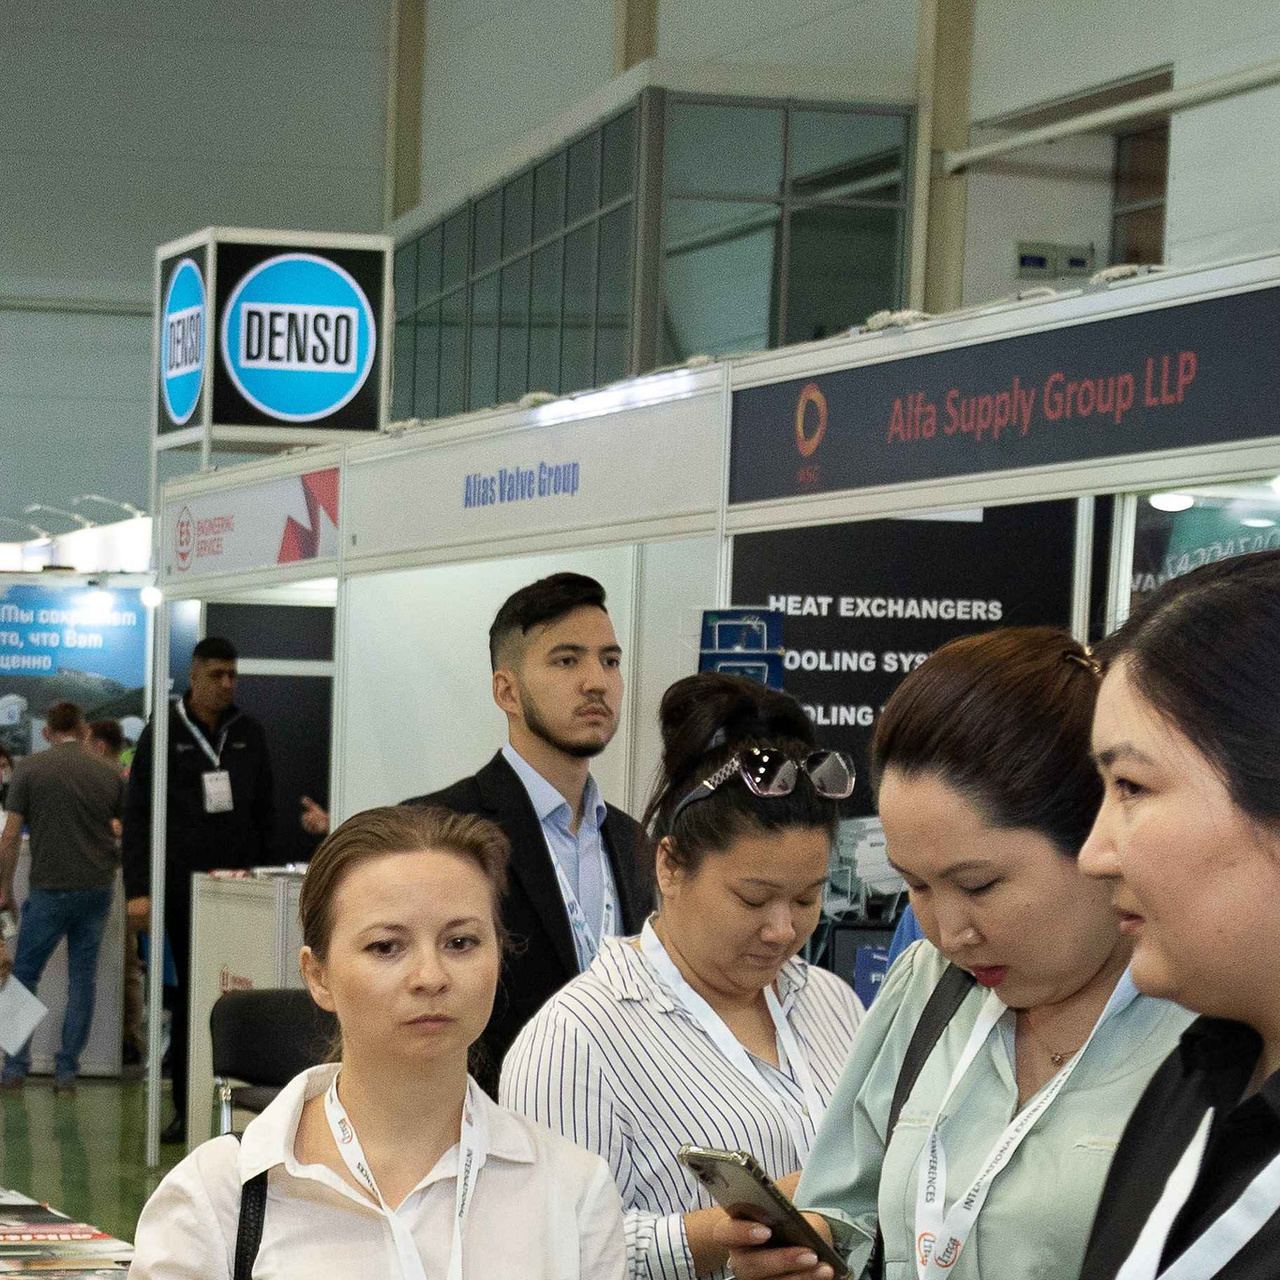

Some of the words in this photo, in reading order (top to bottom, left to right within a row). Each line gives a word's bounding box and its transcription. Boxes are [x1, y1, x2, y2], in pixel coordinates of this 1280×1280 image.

[169, 313, 202, 370] DENSO
[246, 310, 353, 366] DENSO
[887, 391, 938, 445] Alfa
[943, 375, 1038, 443] Supply
[1043, 371, 1135, 425] Group
[1145, 350, 1199, 408] LLP
[498, 466, 536, 504] Valve
[538, 460, 580, 498] Group
[0, 604, 34, 625] Мы
[768, 594, 833, 617] HEAT
[839, 598, 1004, 621] EXCHANGERS
[26, 631, 60, 648] что
[63, 628, 103, 649] Вам
[0, 654, 53, 671] ценно
[784, 650, 877, 673] OOLING
